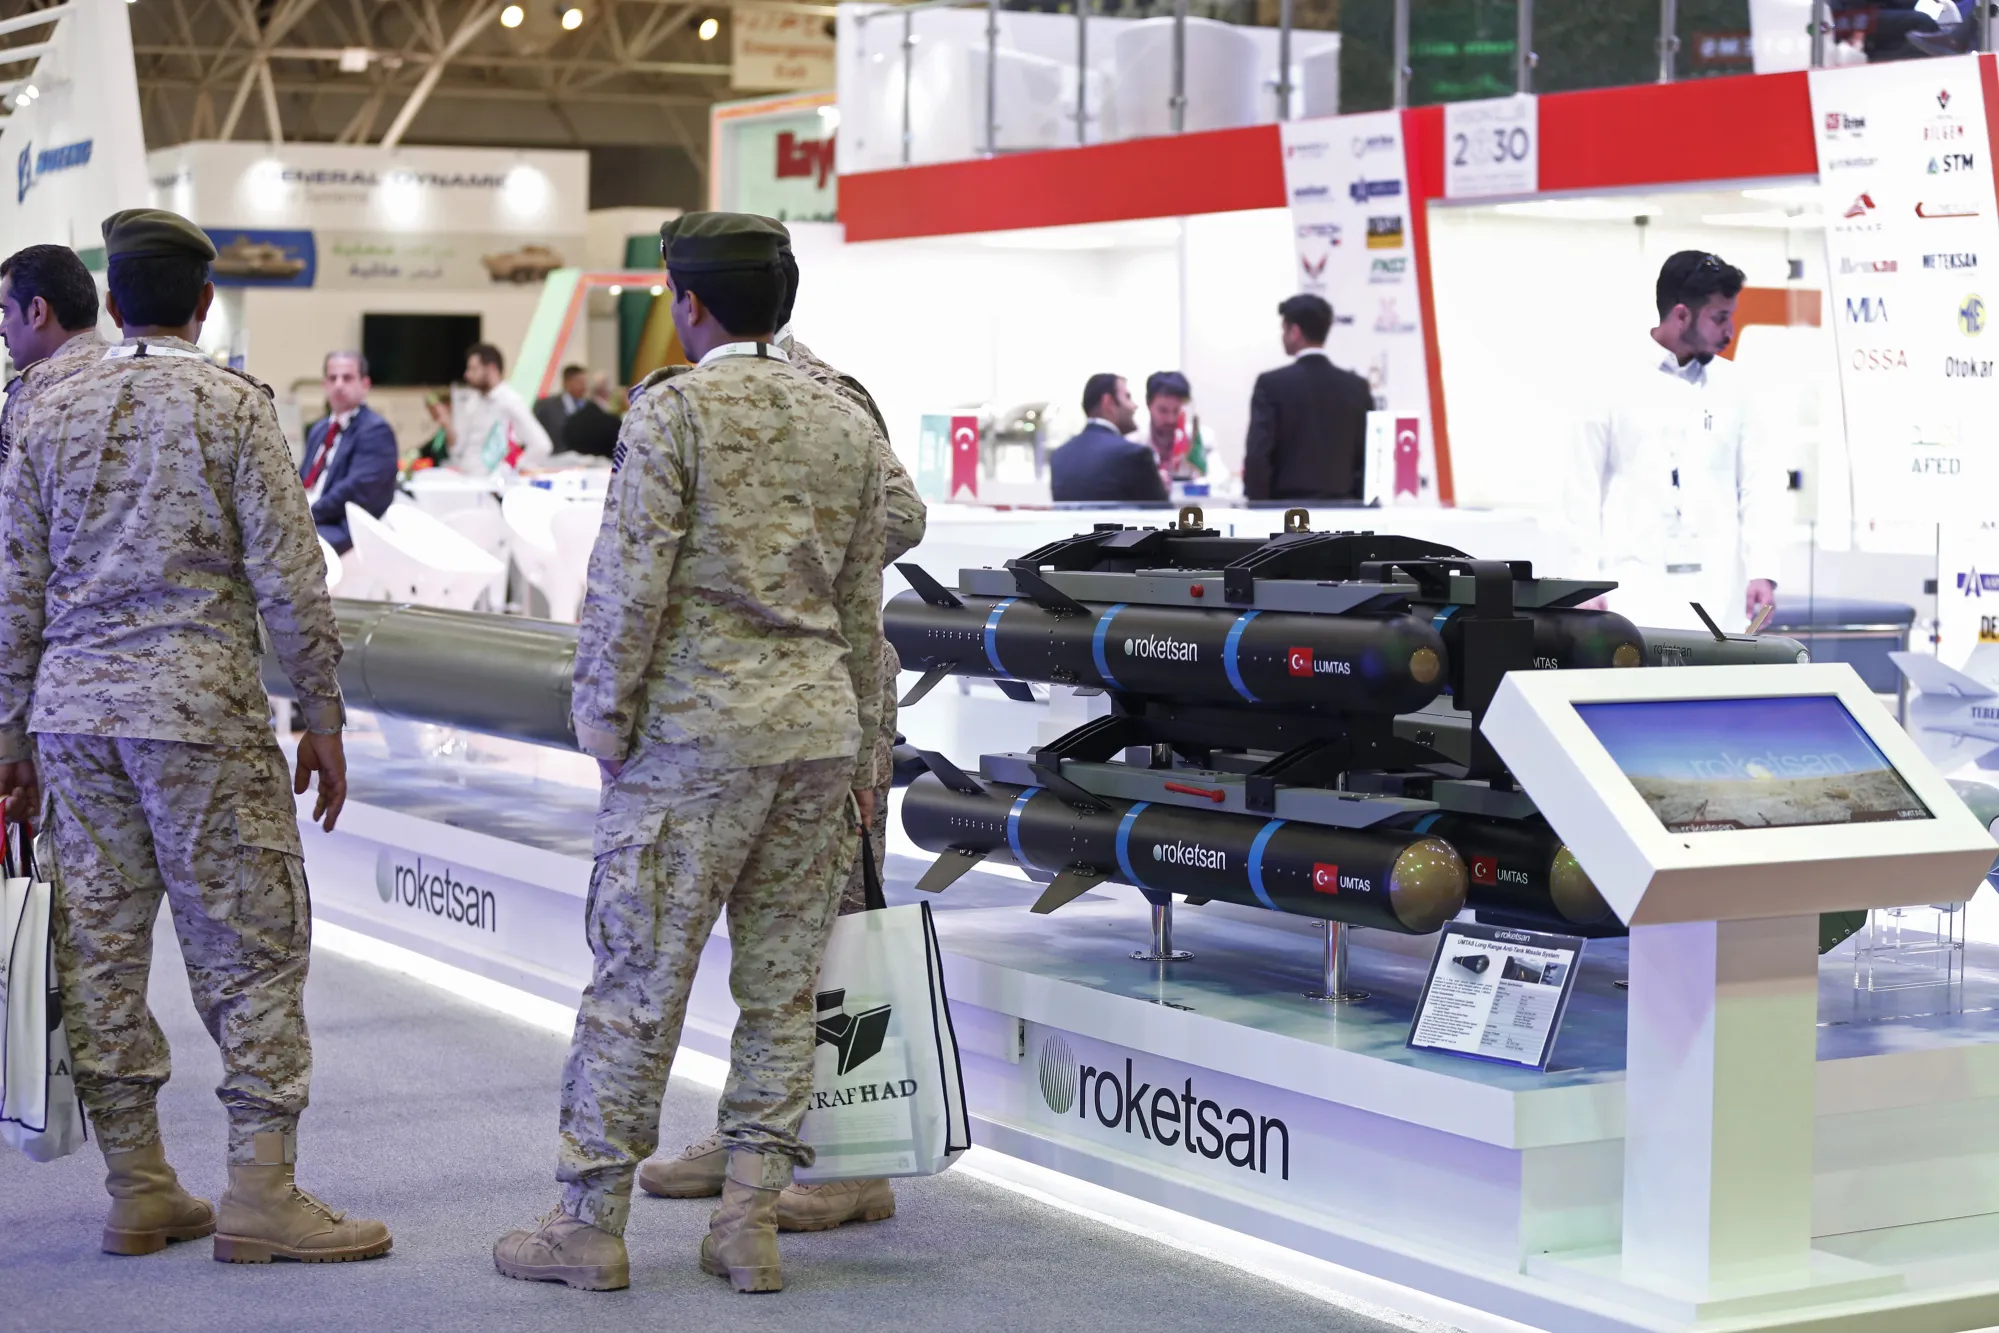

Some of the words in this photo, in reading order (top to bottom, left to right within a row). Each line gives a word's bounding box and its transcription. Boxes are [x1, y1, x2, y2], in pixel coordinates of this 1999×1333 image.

[1943, 153, 1974, 173] STM
[279, 169, 380, 187] ENERAL
[1852, 348, 1908, 371] OSSA
[1945, 356, 1994, 378] Otokar
[1134, 634, 1199, 662] roketsan
[1313, 659, 1351, 675] LUMTAS
[1533, 656, 1558, 670] MTAS
[1163, 840, 1227, 871] roketsan
[1339, 876, 1371, 893] UMTAS
[1496, 868, 1529, 885] UMTAS
[395, 856, 496, 933] roketsan
[1500, 930, 1531, 943] roketsan
[1457, 938, 1475, 947] UMTAS
[1475, 942, 1487, 950] Long
[1487, 943, 1503, 952] Range
[1525, 948, 1542, 957] Missile
[1542, 951, 1560, 960] System
[1079, 1057, 1290, 1181] roketsan
